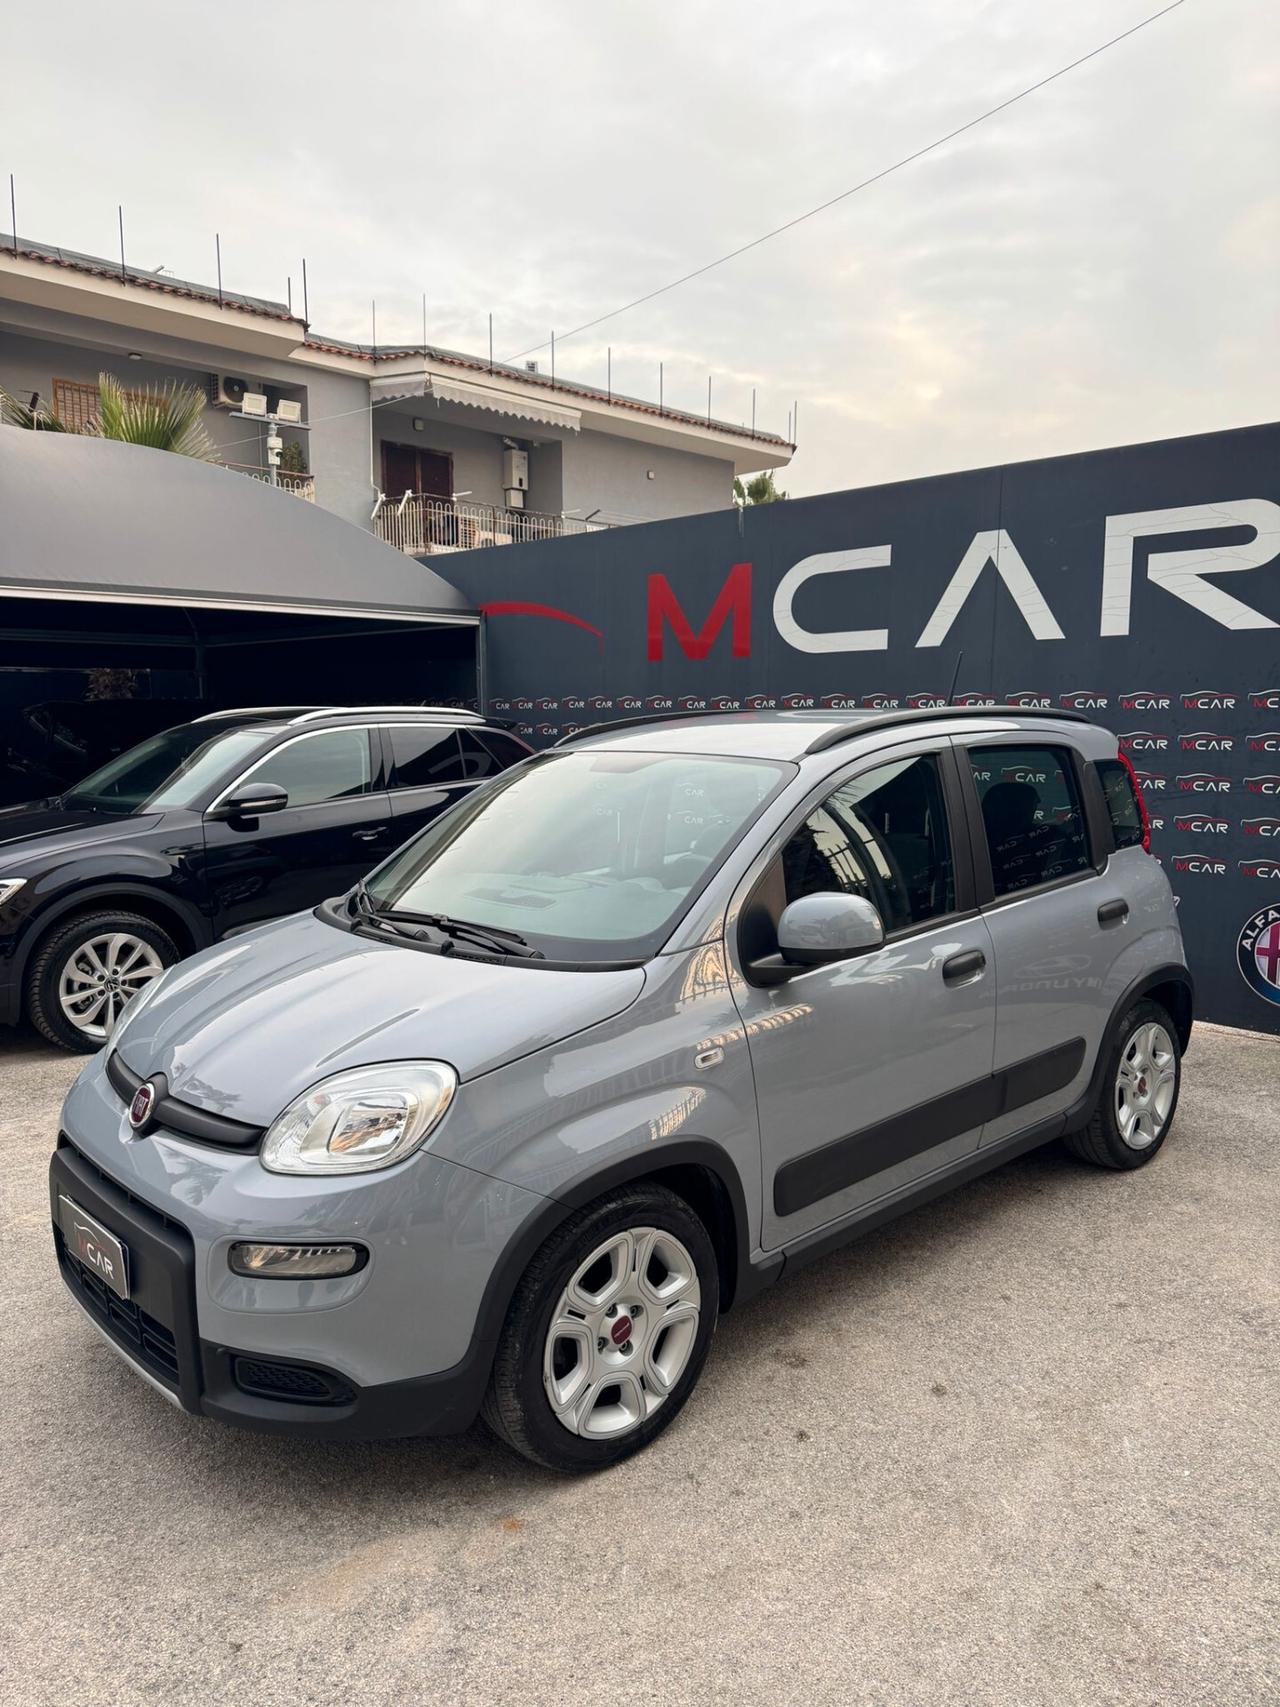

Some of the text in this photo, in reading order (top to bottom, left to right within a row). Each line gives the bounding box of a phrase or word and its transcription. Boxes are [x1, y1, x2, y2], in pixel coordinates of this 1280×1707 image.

[647, 498, 1280, 662] MCAR
[1122, 699, 1170, 709] MCAR
[1183, 698, 1236, 709] MCAR
[1119, 739, 1168, 750] MCAR
[1181, 740, 1233, 751] MCAR
[1179, 781, 1231, 793] MCAR
[1175, 821, 1228, 834] MCAR
[1174, 862, 1226, 875] MCAR
[1241, 910, 1280, 951] ALFA
